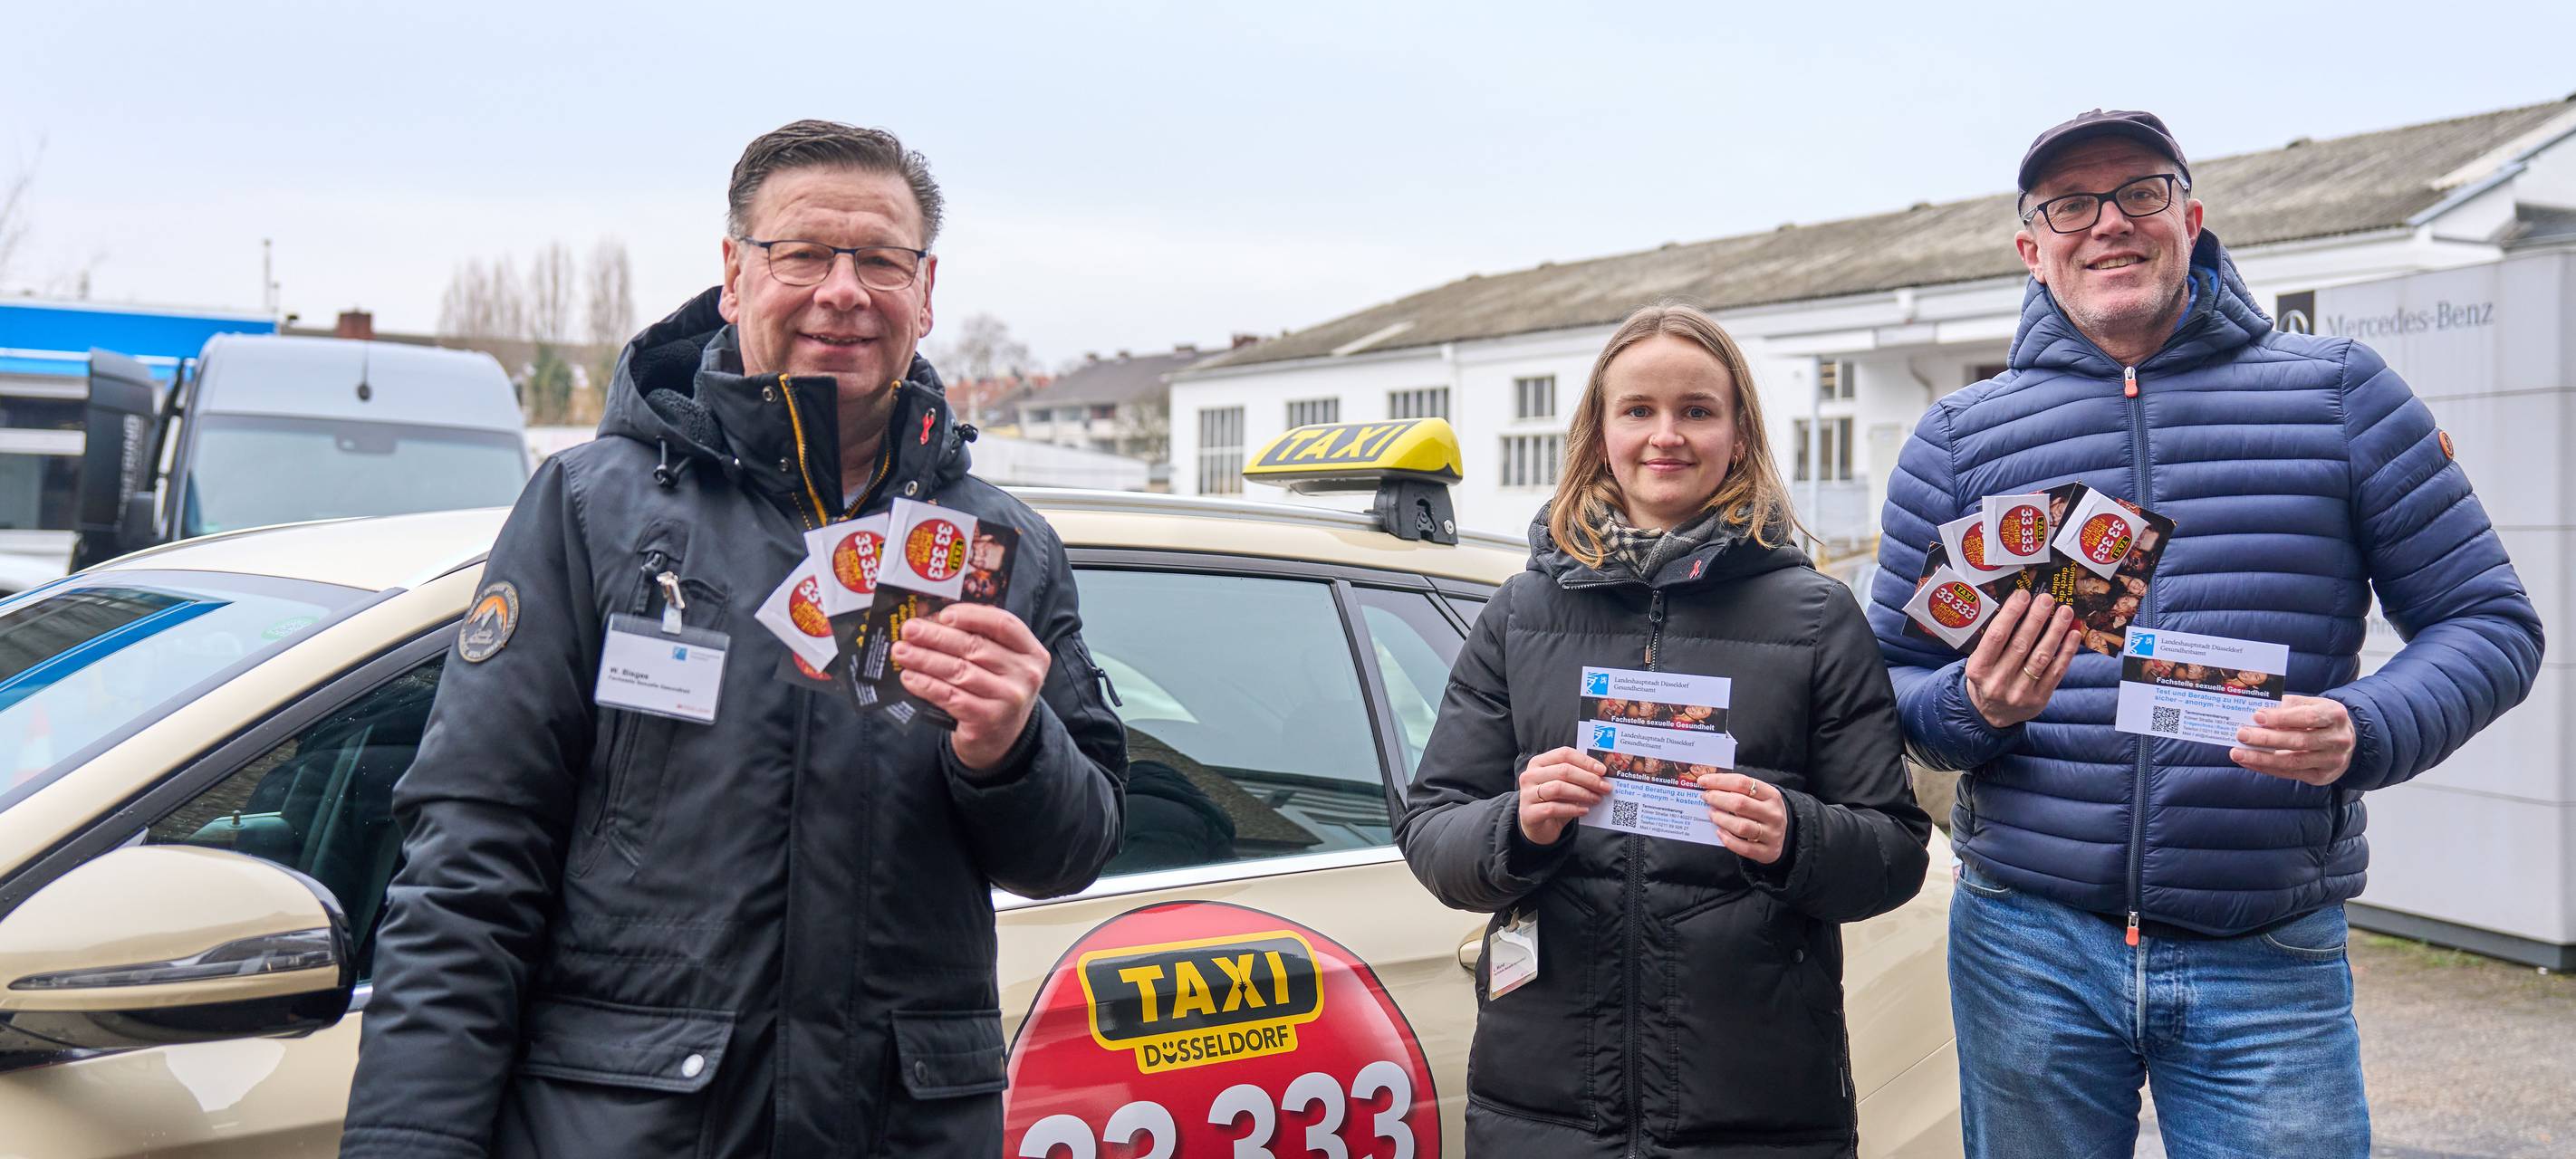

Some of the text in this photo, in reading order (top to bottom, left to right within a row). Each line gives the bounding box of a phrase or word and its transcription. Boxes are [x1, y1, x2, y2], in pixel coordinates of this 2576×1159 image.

[2326, 300, 2494, 339] Mercedes-Benz
[1277, 425, 1406, 461] TAXI
[2021, 508, 2033, 552] 33 333
[2091, 524, 2108, 546] SICHER
[2108, 520, 2124, 538] 33
[928, 523, 953, 579] 33 333
[2092, 536, 2113, 560] 333
[2113, 538, 2128, 556] TAXI
[855, 533, 878, 589] 33 333
[2052, 572, 2060, 594] tollen
[2058, 567, 2069, 602] durch die
[2067, 560, 2077, 595] Kommen
[1956, 586, 1974, 599] TAXI
[1937, 588, 1953, 603] 33
[1952, 599, 1975, 618] 333
[1938, 602, 1960, 618] SICHER
[2160, 646, 2206, 656] Gesundheitsamt
[2161, 638, 2243, 654] Landeshauptstadt Düsseldorf
[1614, 676, 1689, 689] Landeshauptstadt Düsseldorf
[1614, 685, 1656, 694] Gesundheitsamt
[2157, 677, 2270, 697] Fachstelle sexuelle Gesundheit
[2186, 700, 2214, 709] anonym
[2188, 692, 2221, 703] Beratung
[1611, 715, 1715, 732] Fachstelle sexuelle Gesundheit
[1620, 732, 1695, 747] Landeshauptstadt Düsseldorf
[1620, 739, 1662, 750] Gesundheitsamt
[1617, 771, 1650, 781] Fachstelle
[1651, 776, 1678, 785] sexuelle
[1615, 788, 1634, 796] sicher
[1642, 793, 1668, 801] anonym
[1646, 786, 1675, 796] Beratung
[1119, 951, 1290, 1023] TAXI
[1143, 1024, 1290, 1068] DÜSSELDORF
[1207, 1060, 1415, 1159] 333
